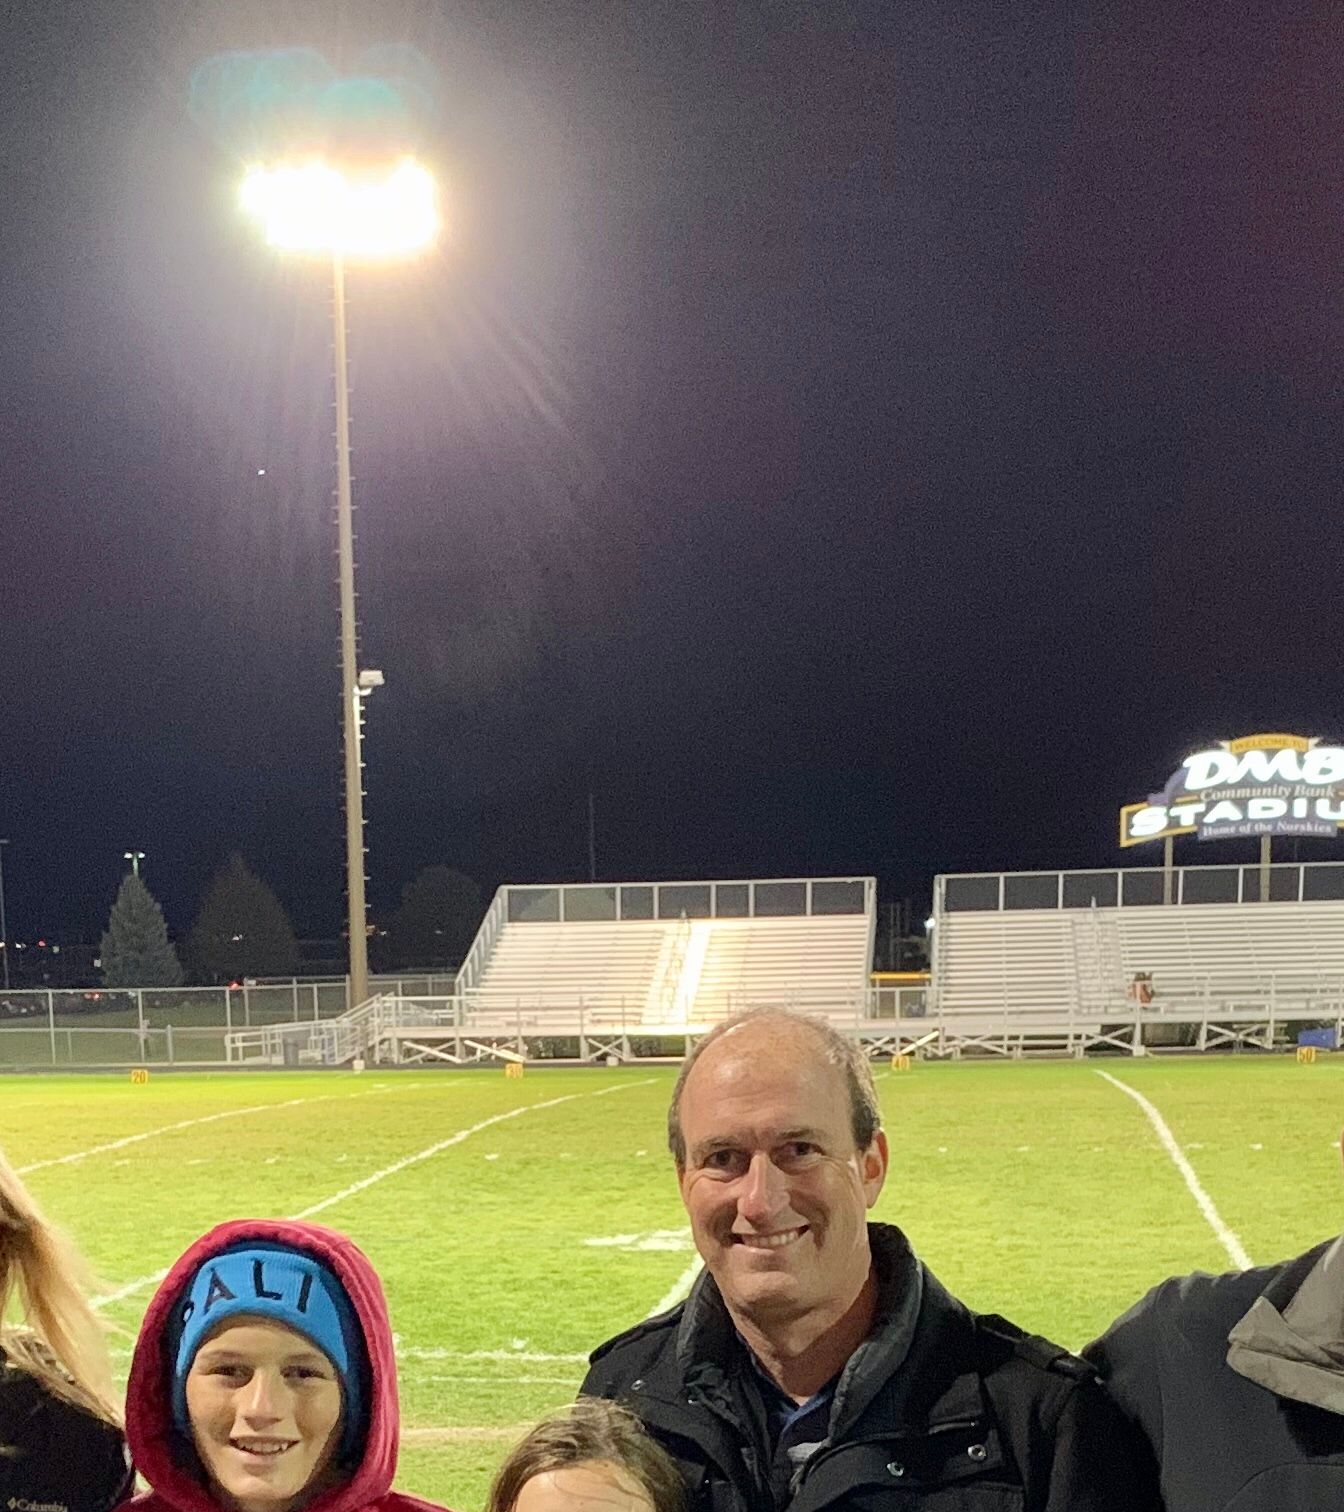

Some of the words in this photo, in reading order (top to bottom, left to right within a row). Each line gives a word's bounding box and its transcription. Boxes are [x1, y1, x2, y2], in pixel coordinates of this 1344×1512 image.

[1200, 784, 1291, 801] Community
[1294, 784, 1336, 798] Bank
[1202, 824, 1236, 836] Home
[1239, 822, 1251, 833] of
[1253, 821, 1273, 832] the
[1275, 820, 1332, 834] Norskies
